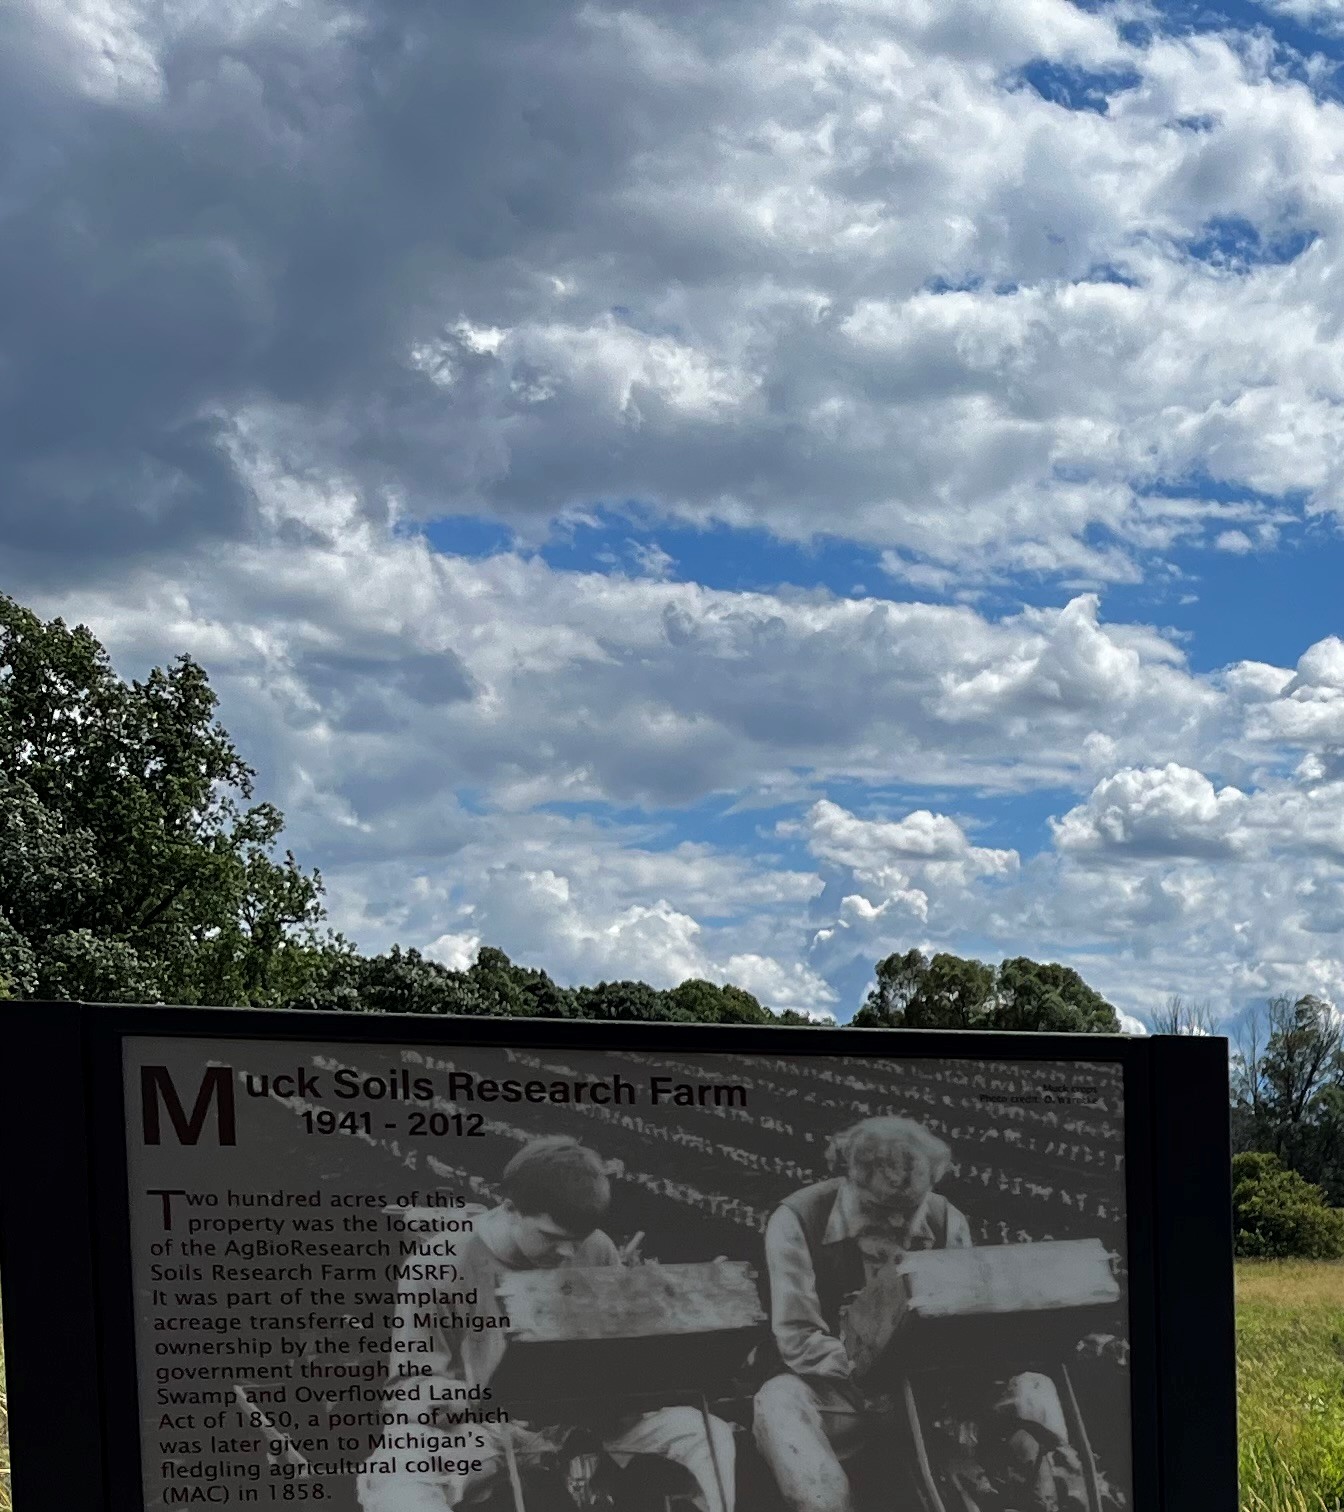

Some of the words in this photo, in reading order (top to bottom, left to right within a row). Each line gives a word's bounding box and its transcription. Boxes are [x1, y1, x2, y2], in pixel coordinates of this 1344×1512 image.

[333, 1069, 434, 1102] Soils
[448, 1071, 636, 1105] Research
[650, 1075, 747, 1108] Farm
[300, 1110, 372, 1136] 1941
[408, 1111, 485, 1137] 2012
[226, 1189, 321, 1208] hundred
[330, 1193, 388, 1208] acres
[395, 1189, 418, 1208] of
[426, 1189, 466, 1208] this
[188, 1214, 285, 1238] property
[291, 1218, 334, 1232] was
[342, 1213, 378, 1232] the
[386, 1213, 473, 1232] location
[149, 1238, 172, 1257] of
[180, 1238, 216, 1257] the
[223, 1237, 390, 1261] AgBioResearch
[398, 1236, 456, 1256] Muck
[150, 1263, 203, 1282] Soils
[211, 1262, 312, 1281] Research
[321, 1262, 376, 1281] Farm
[384, 1261, 464, 1285] (MSRF).
[153, 1316, 241, 1335] acreage
[249, 1310, 374, 1330] transferred
[382, 1310, 405, 1329] to
[412, 1309, 510, 1333] Michigan
[161, 1458, 260, 1482] fledgling
[269, 1455, 396, 1481] agricultural
[404, 1454, 482, 1478] college
[162, 1482, 230, 1507] (MAC)
[238, 1482, 258, 1501] in
[270, 1480, 331, 1500] 1858.
